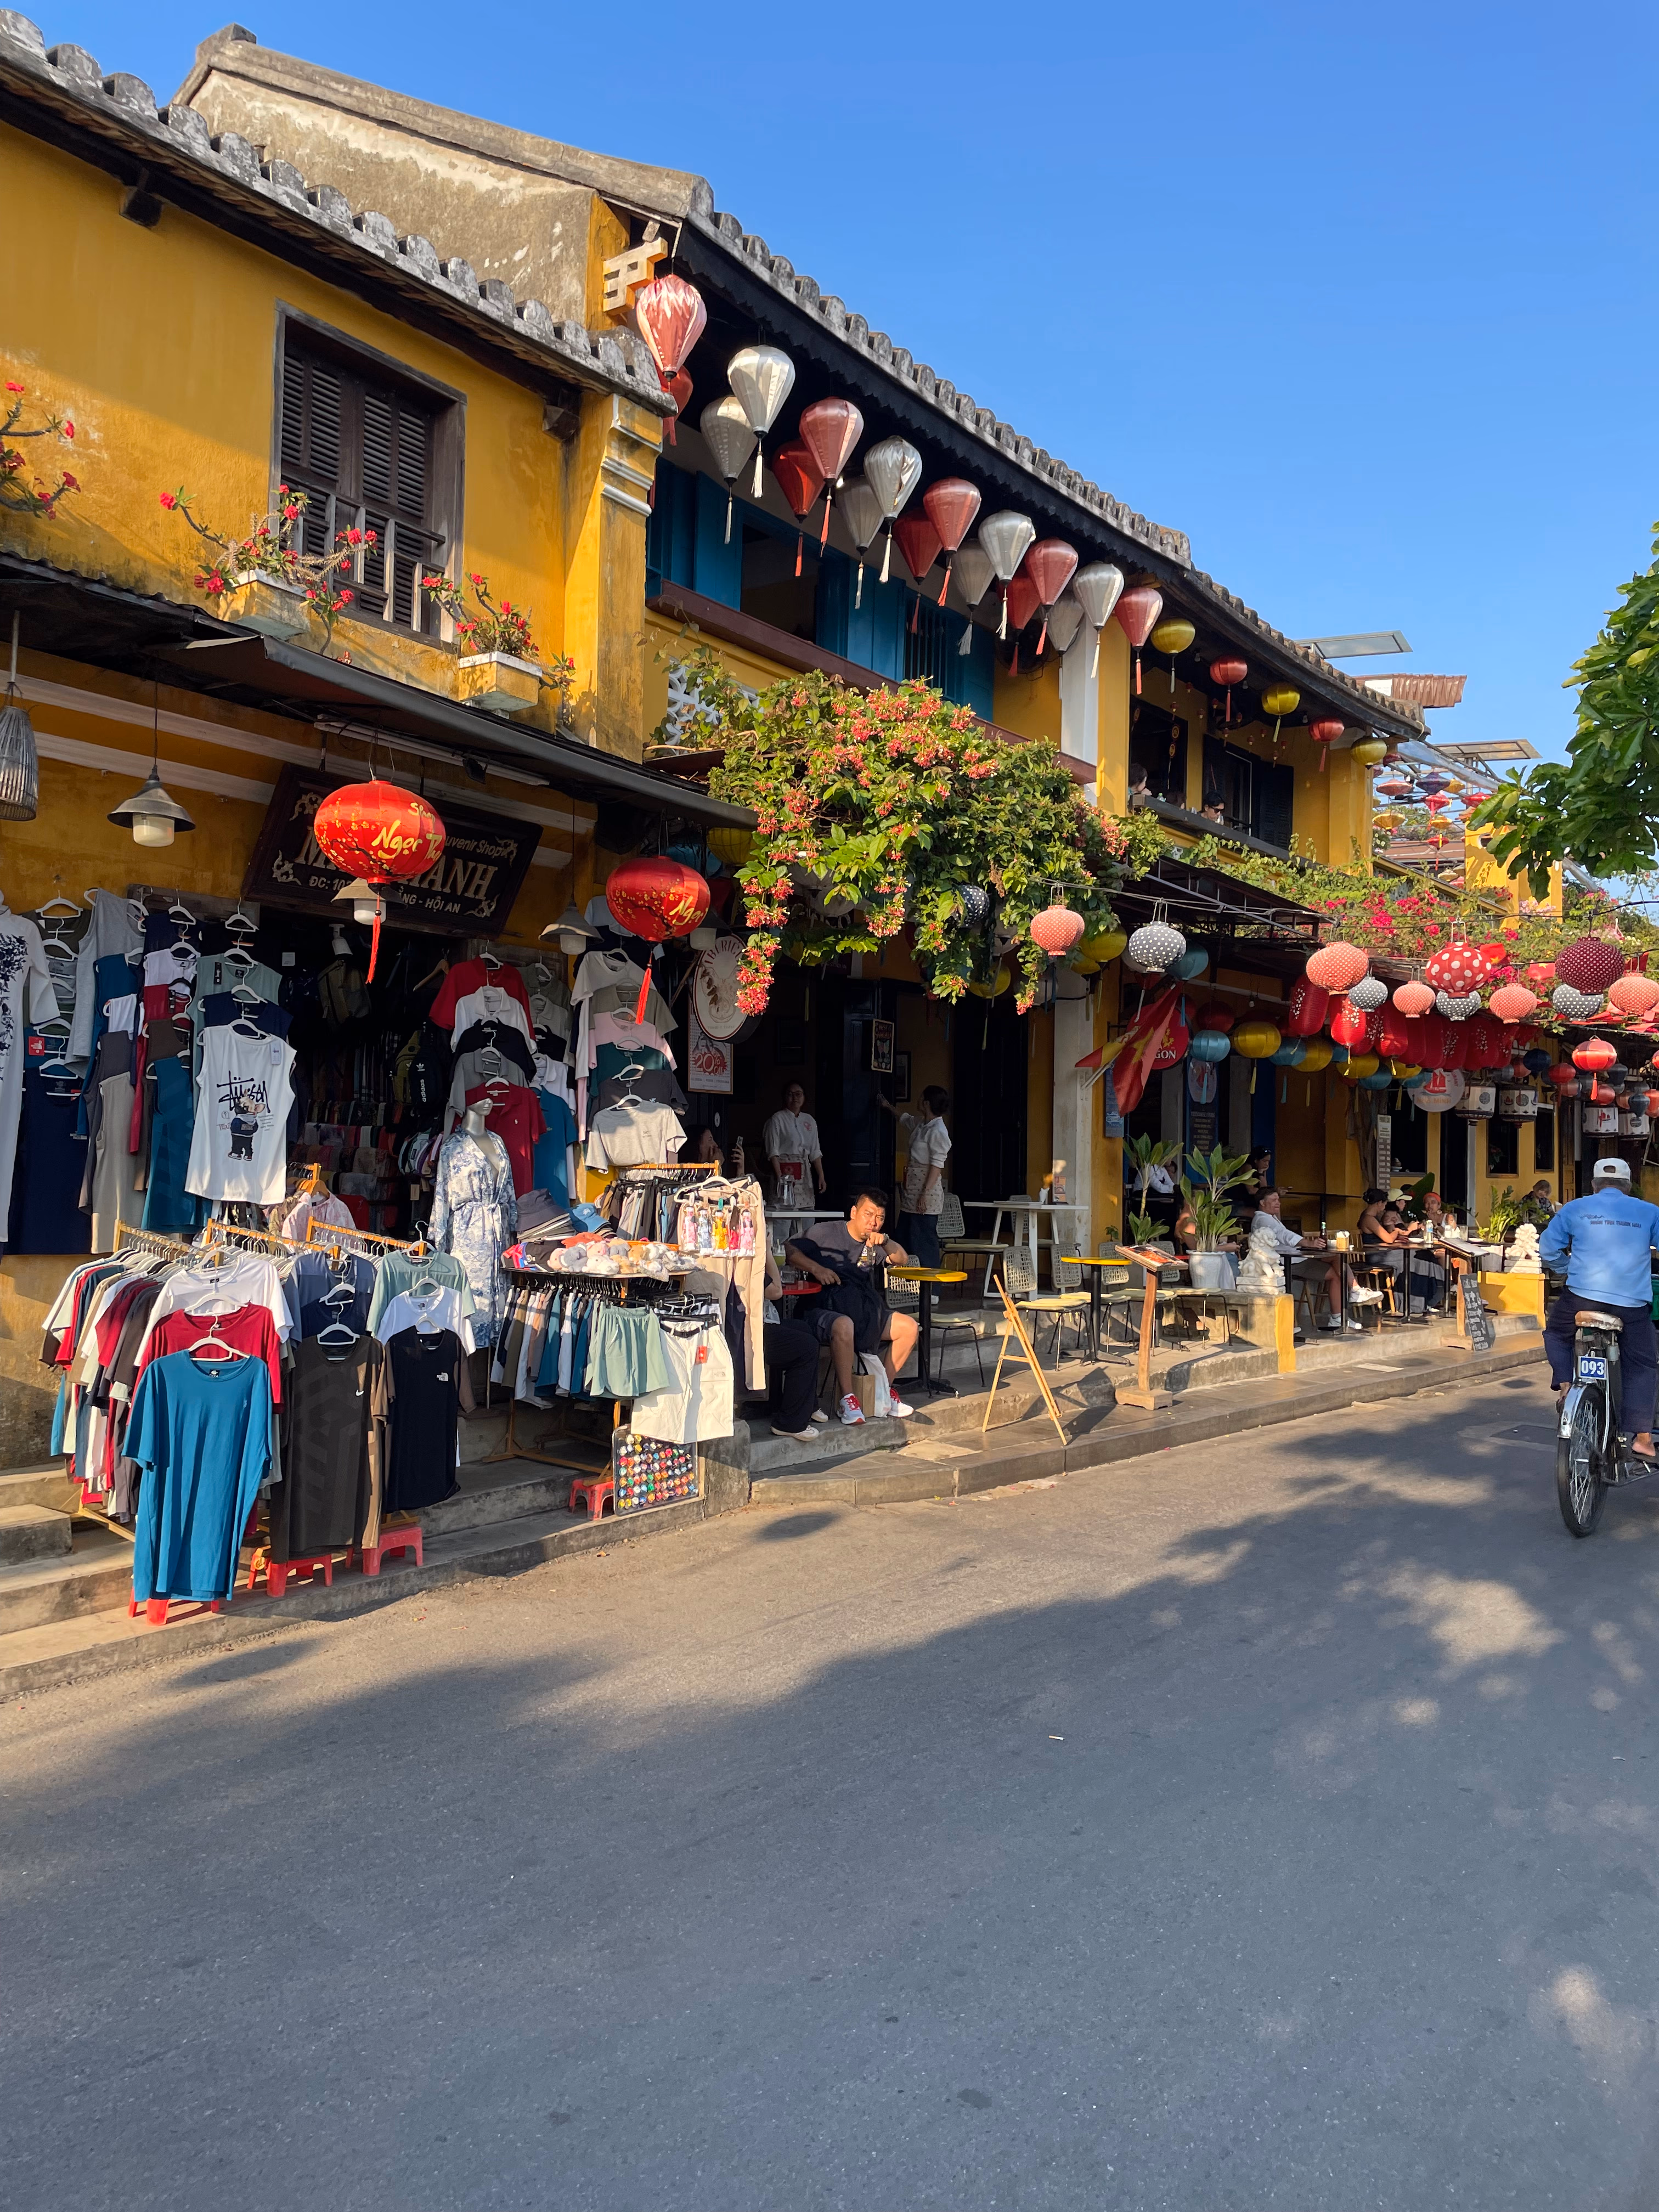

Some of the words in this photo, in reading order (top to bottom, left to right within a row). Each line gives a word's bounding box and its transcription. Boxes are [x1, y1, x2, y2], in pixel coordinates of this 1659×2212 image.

[408, 803, 436, 833] Shop
[371, 819, 423, 860] Ngọc
[445, 836, 479, 851] uvenir
[475, 839, 503, 859] Shop
[332, 878, 352, 891] 10
[425, 895, 444, 912] HỘI
[443, 902, 462, 914] AN
[1581, 1360, 1604, 1375] 093
